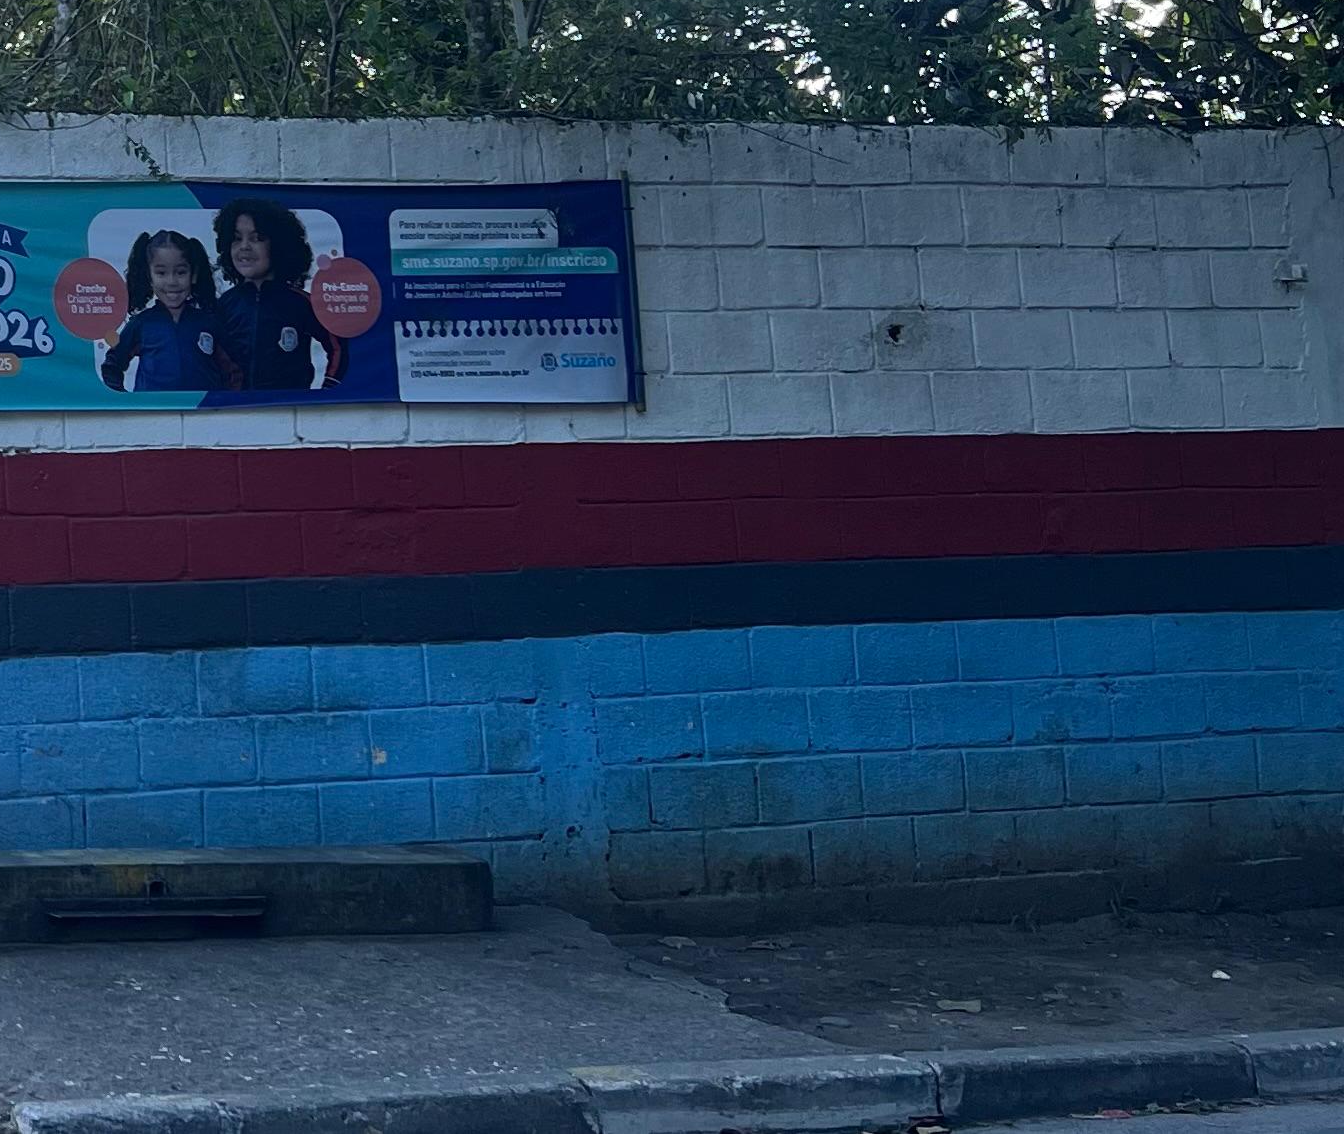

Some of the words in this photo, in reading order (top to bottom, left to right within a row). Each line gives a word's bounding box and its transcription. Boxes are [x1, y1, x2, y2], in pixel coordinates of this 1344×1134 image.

[2, 230, 12, 246] A
[401, 253, 608, 271] sme.suzano.sp.gov.br/inscricao
[76, 283, 107, 293] Creche
[67, 294, 103, 305] Crianças
[104, 294, 115, 303] de
[71, 304, 77, 314] 0
[85, 304, 91, 314] 3
[92, 306, 113, 314] anos
[560, 353, 616, 368] Suzano
